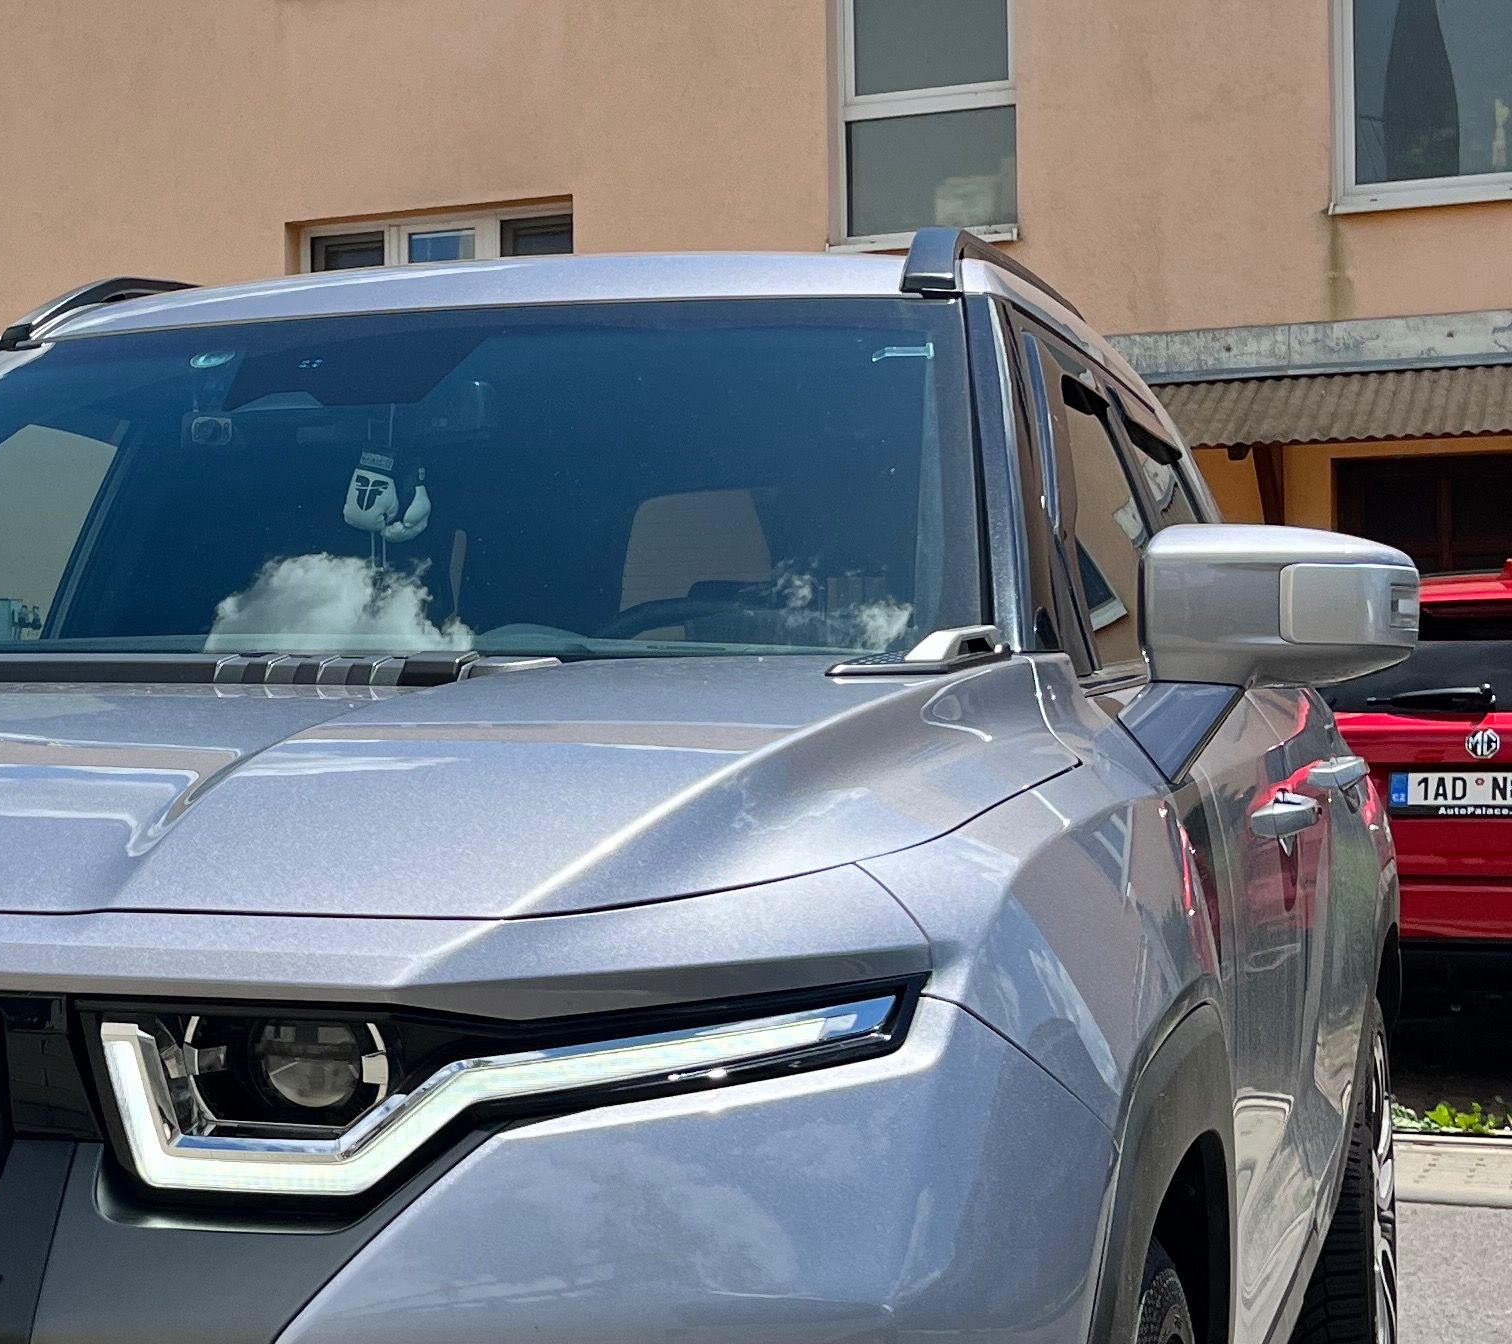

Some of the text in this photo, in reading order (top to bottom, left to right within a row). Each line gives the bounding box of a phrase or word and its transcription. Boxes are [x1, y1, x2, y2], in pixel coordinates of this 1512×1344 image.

[1467, 728, 1498, 757] MG
[1417, 776, 1512, 801] 1AD N
